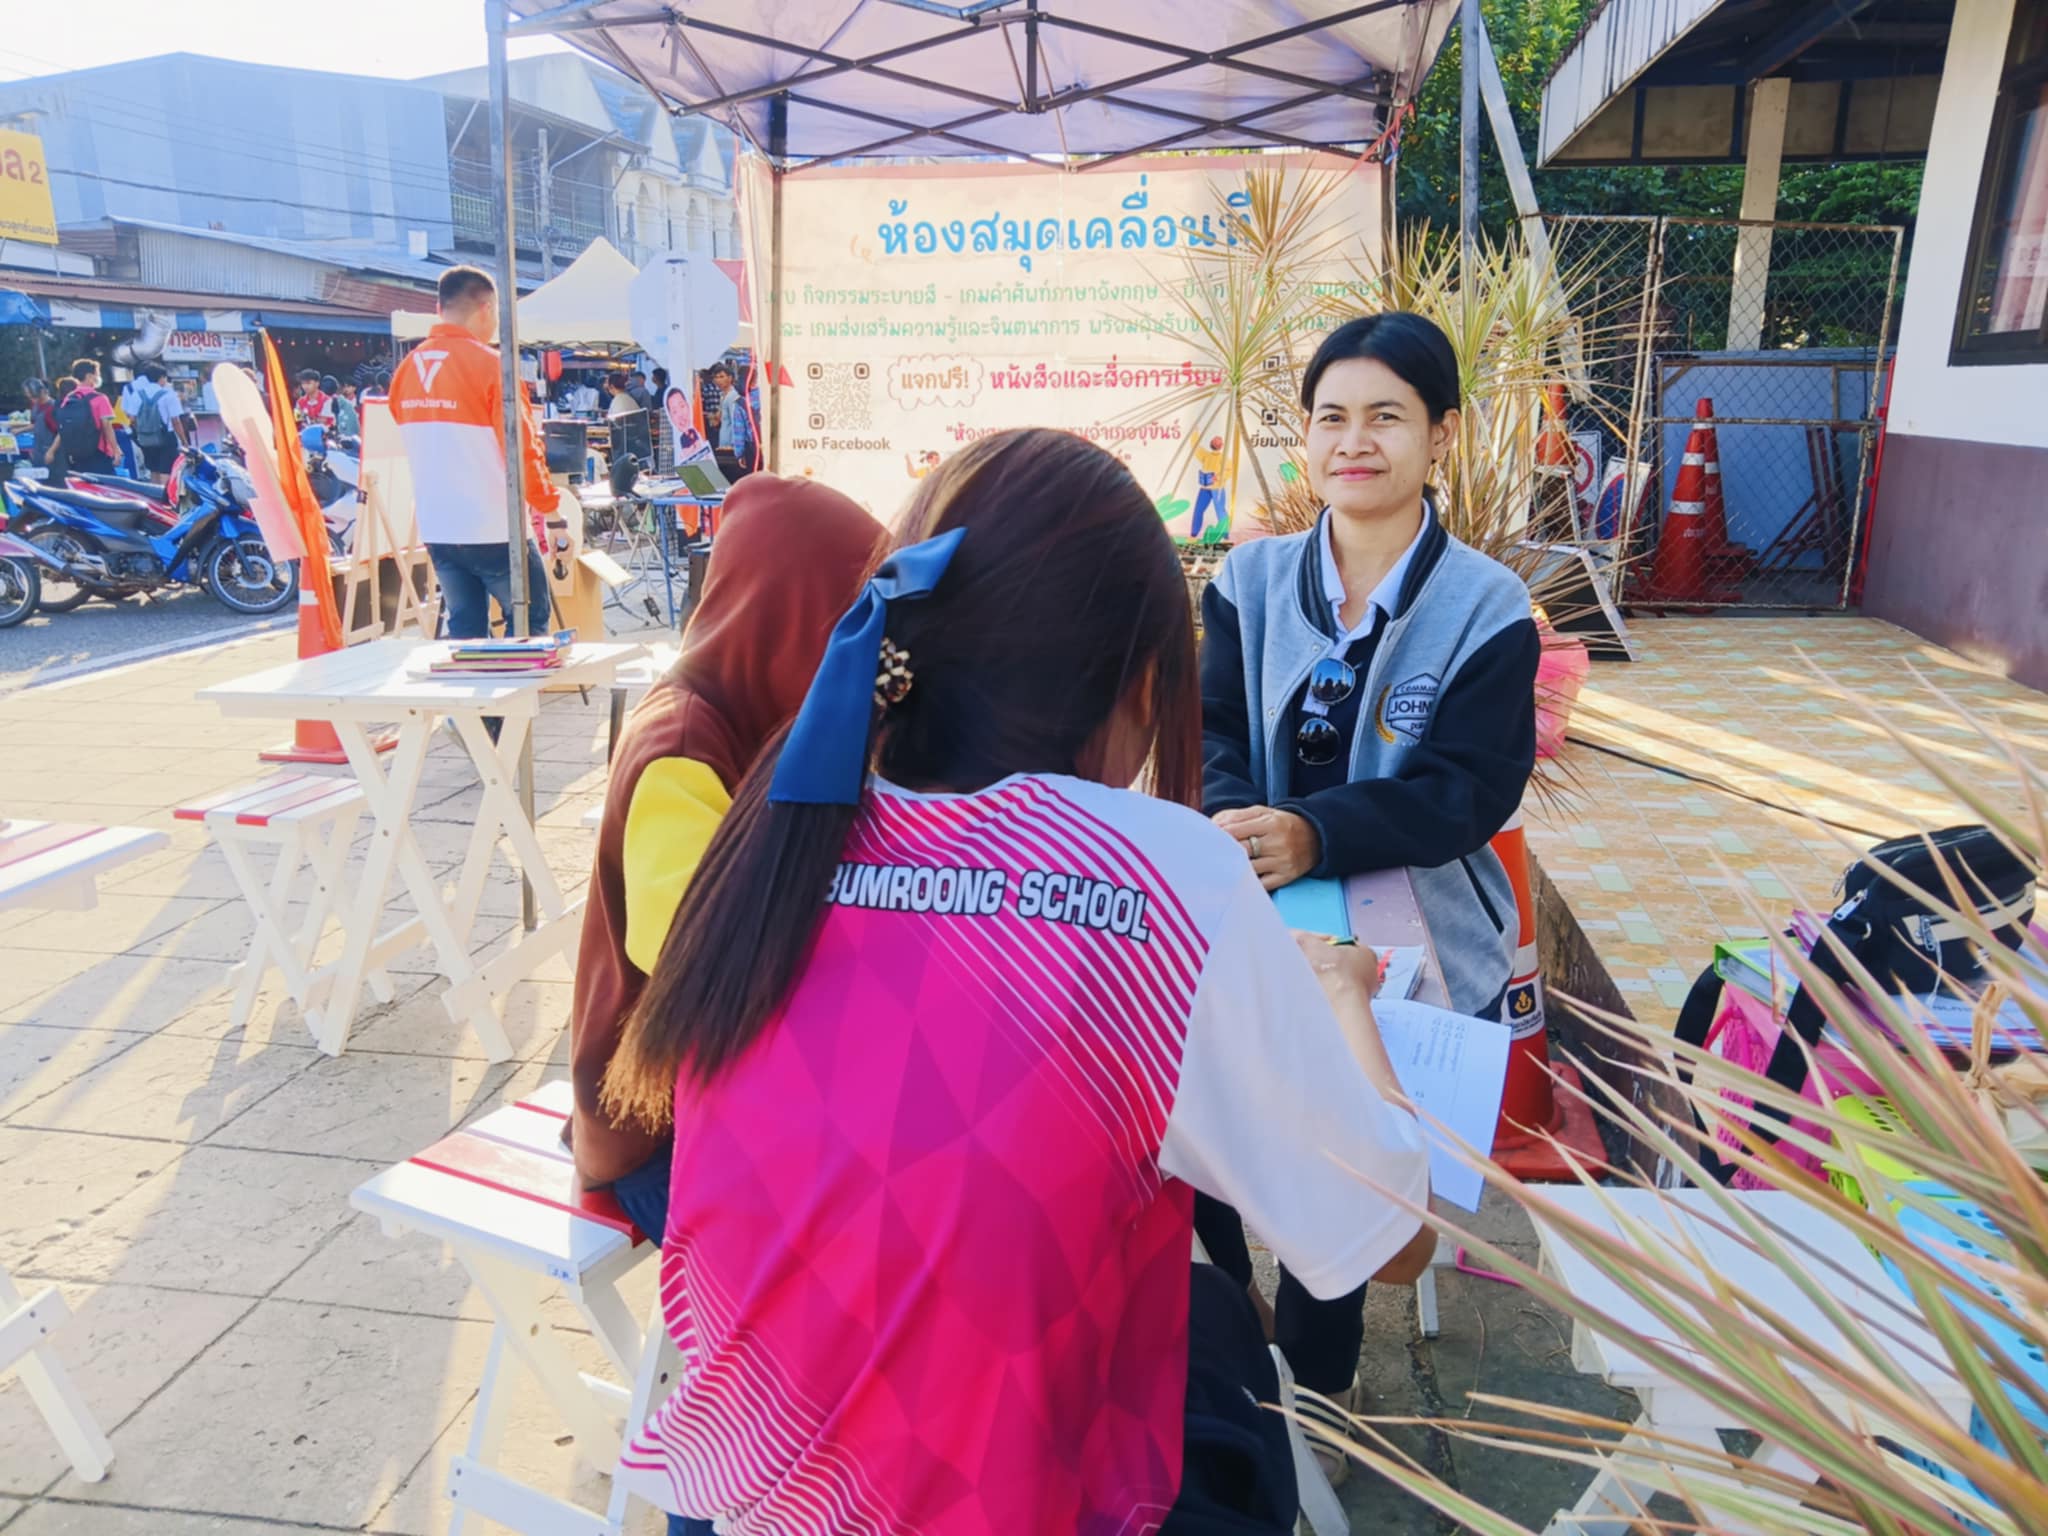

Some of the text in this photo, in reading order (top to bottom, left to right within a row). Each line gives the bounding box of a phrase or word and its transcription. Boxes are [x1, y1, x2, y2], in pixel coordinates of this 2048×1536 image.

[28, 160, 43, 185] 2
[901, 366, 969, 389] แจกฟรี!
[822, 436, 891, 451] Facebook
[1018, 869, 1149, 942] SCHOOL
